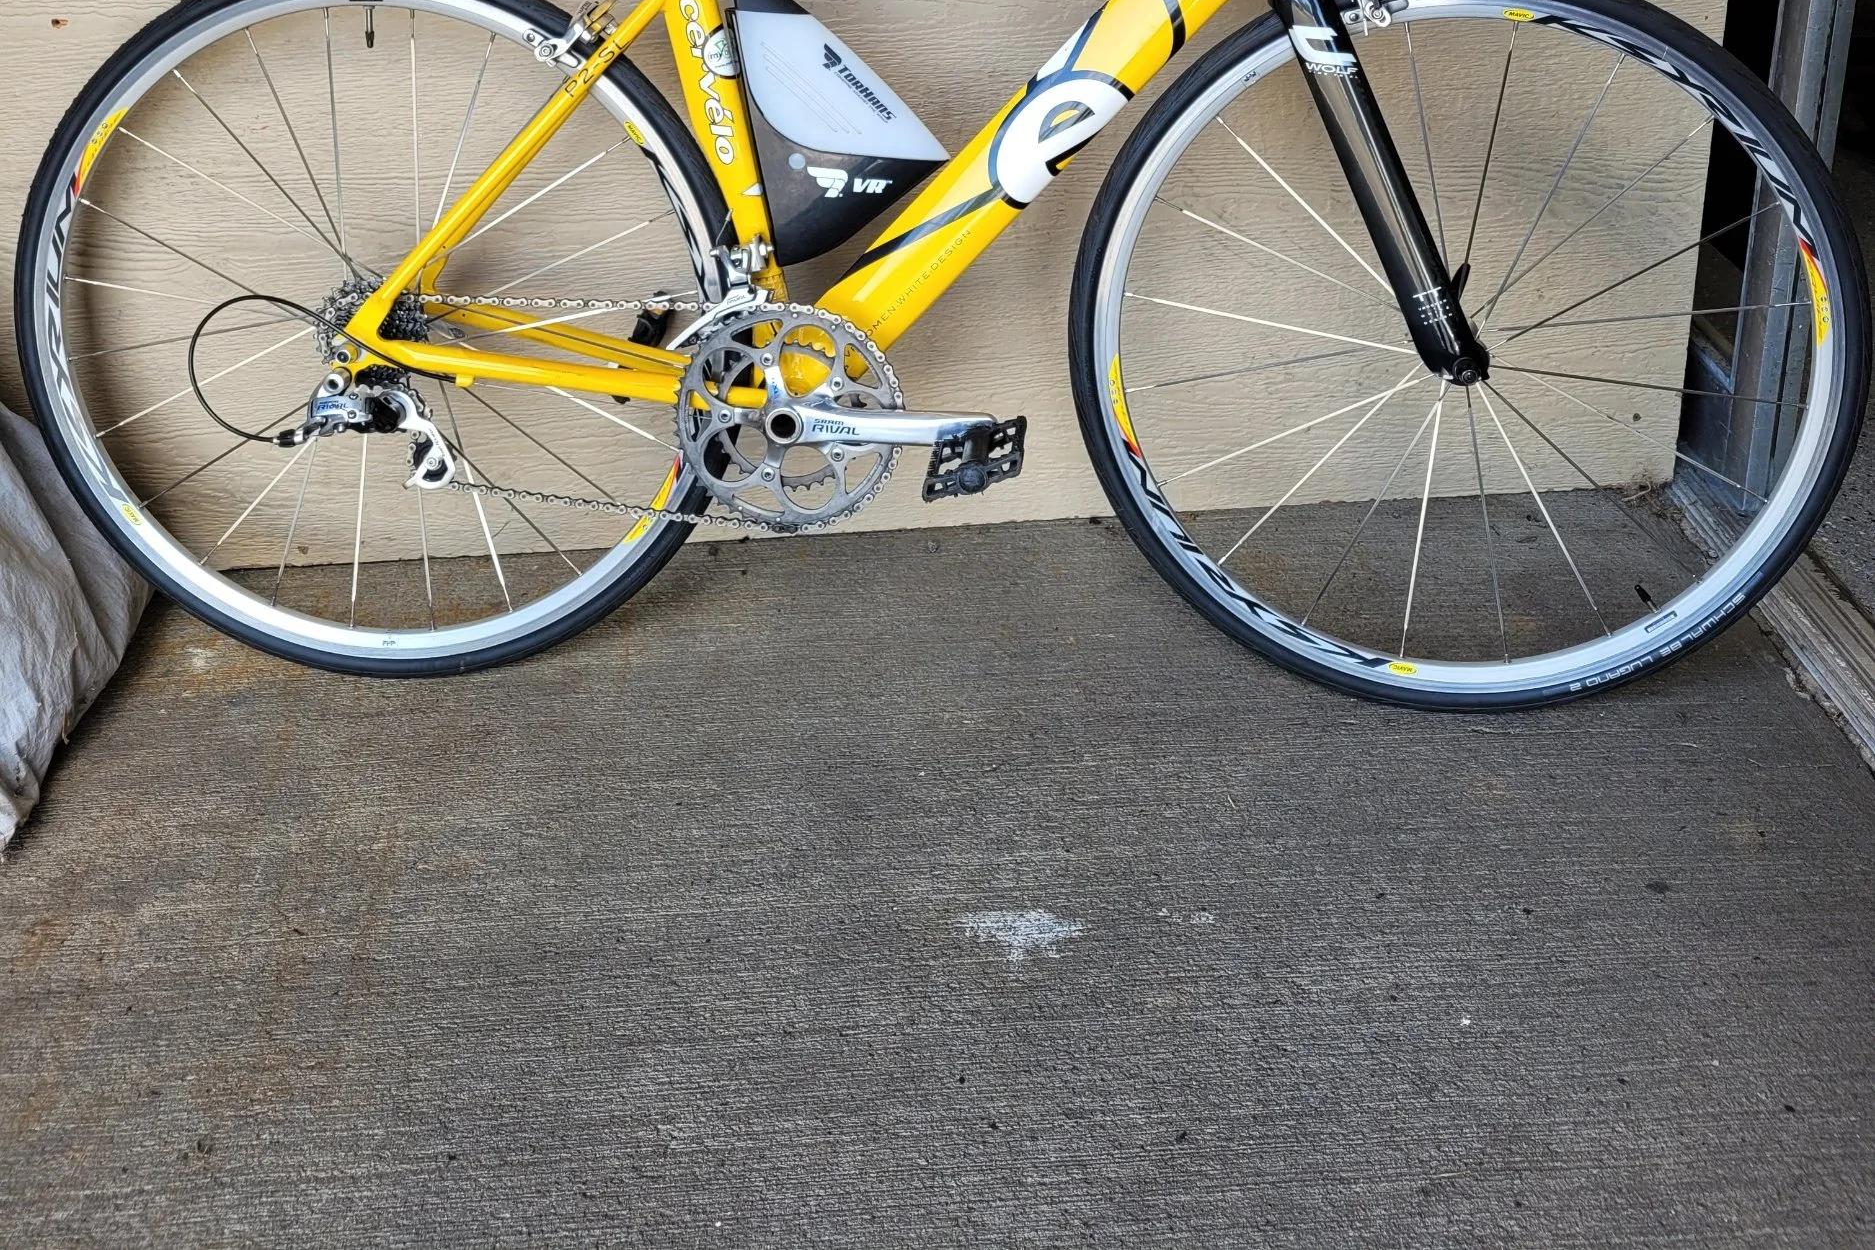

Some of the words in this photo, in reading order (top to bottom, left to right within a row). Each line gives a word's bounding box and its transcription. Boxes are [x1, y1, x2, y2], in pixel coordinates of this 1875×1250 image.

[1508, 11, 1530, 19] MAVIC
[1305, 62, 1358, 75] WOLF
[814, 418, 844, 426] SRAM
[812, 424, 860, 435] RIVAL
[1660, 593, 1746, 657] SCHWALBE
[1586, 656, 1654, 687] LUGANO
